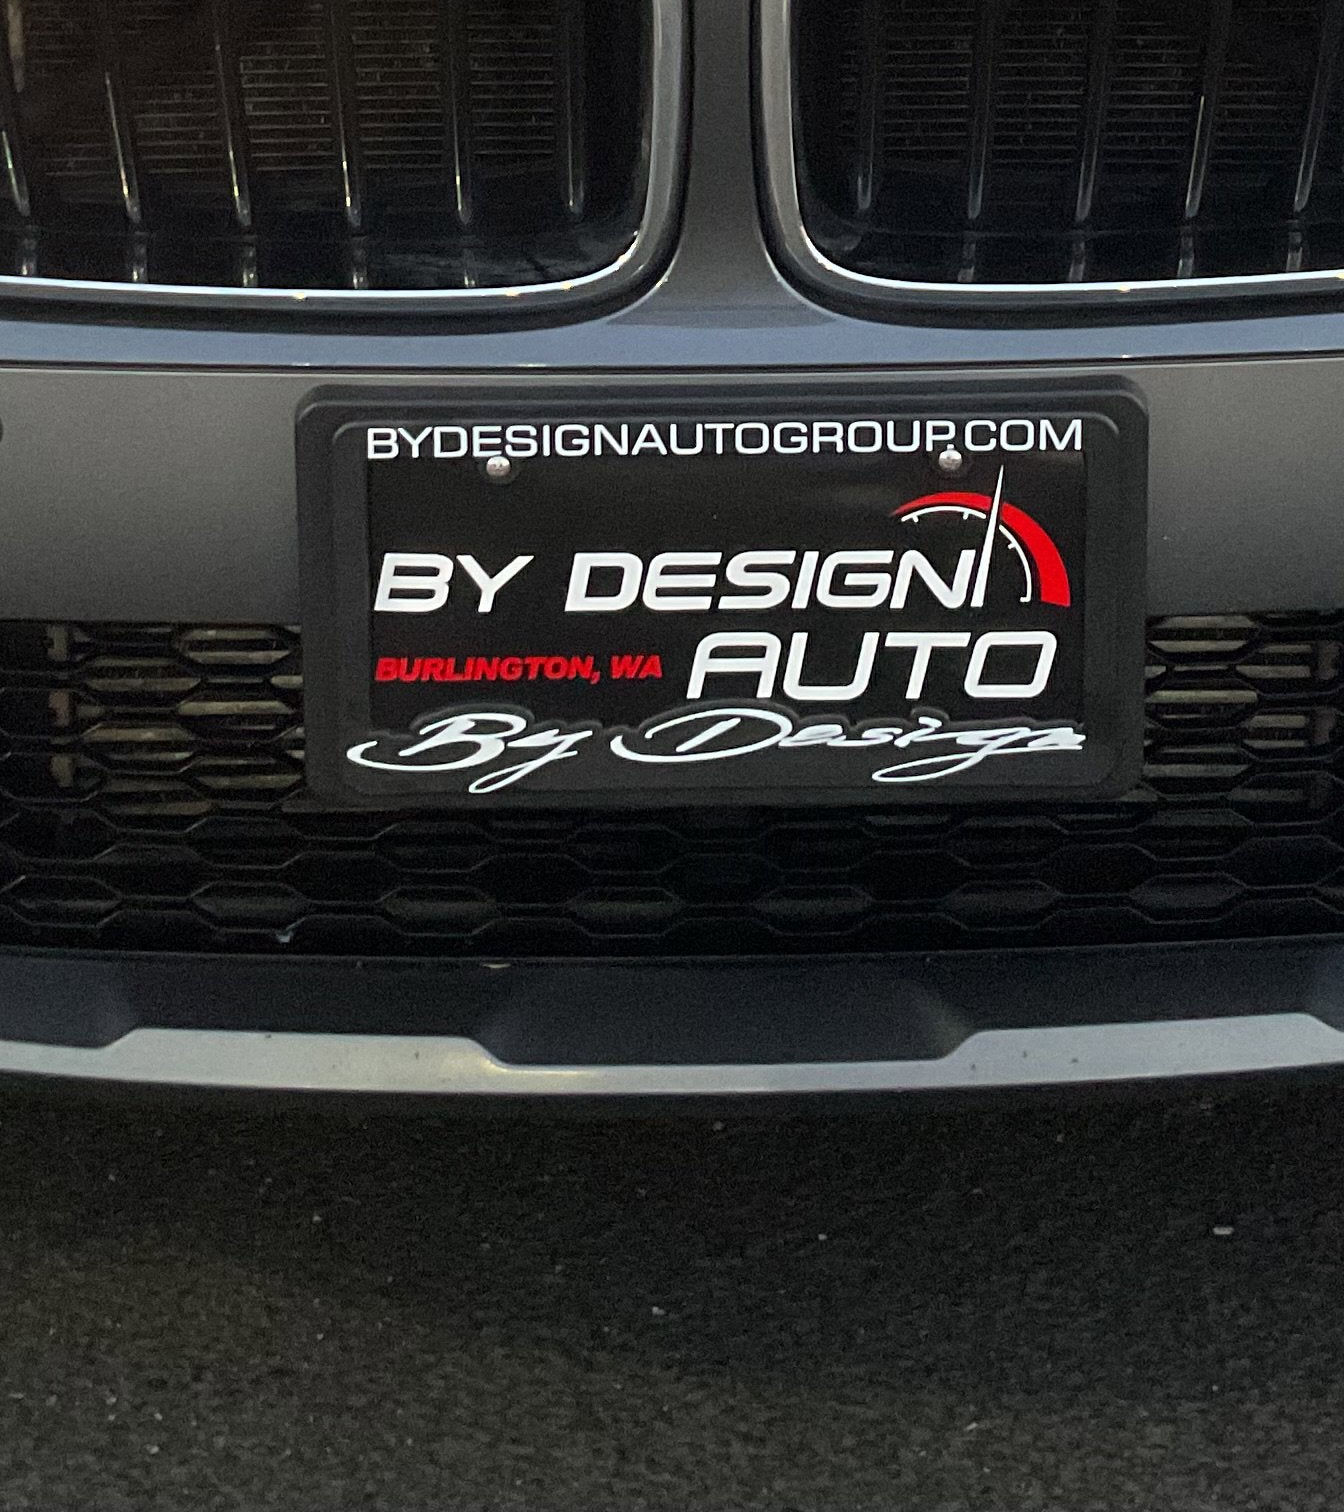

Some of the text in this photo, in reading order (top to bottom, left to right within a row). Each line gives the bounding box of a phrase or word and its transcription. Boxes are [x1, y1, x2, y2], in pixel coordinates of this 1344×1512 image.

[367, 419, 1083, 460] BYDESIGNAUTOGROUP.COM
[373, 549, 977, 613] BY DESIGN
[375, 654, 663, 685] BURLINGTON, WA
[687, 629, 1058, 701] AUTO
[346, 712, 593, 794] By
